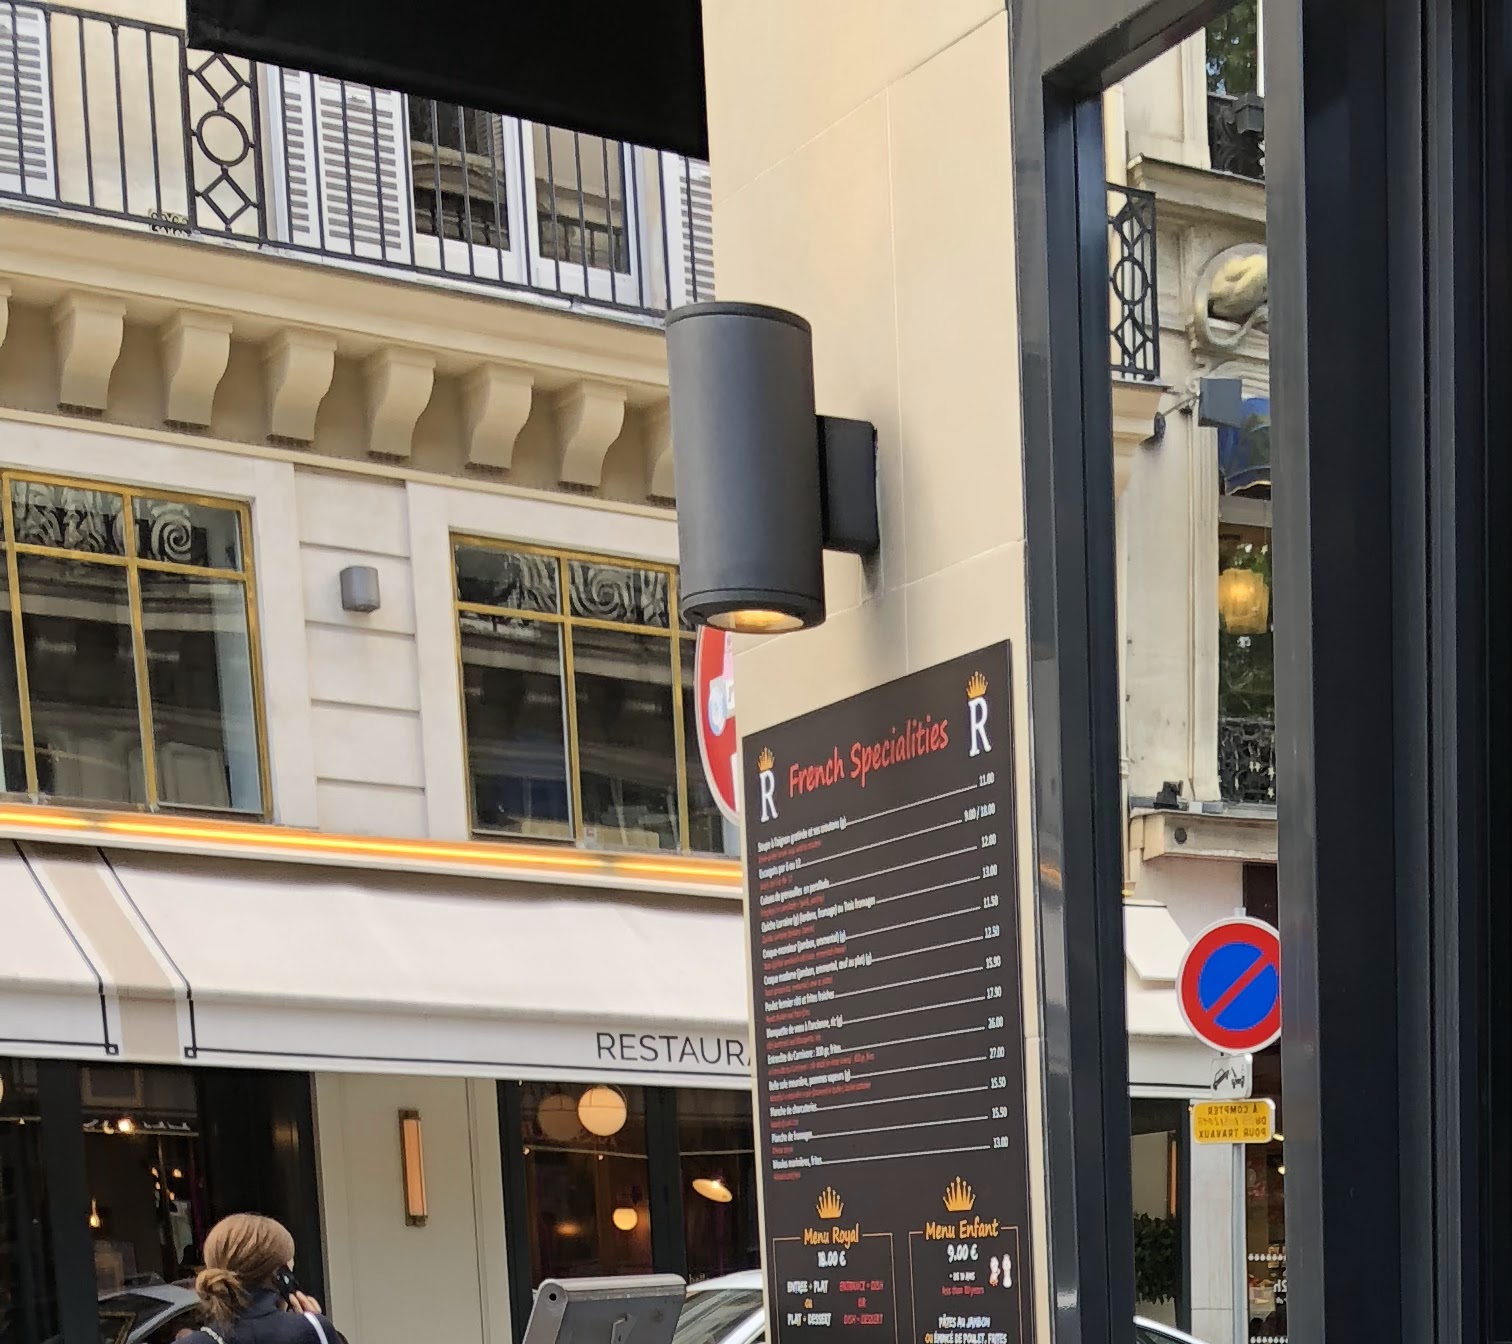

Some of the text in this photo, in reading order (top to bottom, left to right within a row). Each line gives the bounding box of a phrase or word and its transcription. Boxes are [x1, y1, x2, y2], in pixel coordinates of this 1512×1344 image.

[968, 696, 992, 757] R
[788, 714, 949, 799] French Specialities
[759, 769, 780, 823] R
[596, 1032, 751, 1067] RESTAUR
[804, 1222, 859, 1249] Menu Royal
[925, 1215, 999, 1241] Menu Enfant
[947, 1243, 979, 1263] 9.00 €
